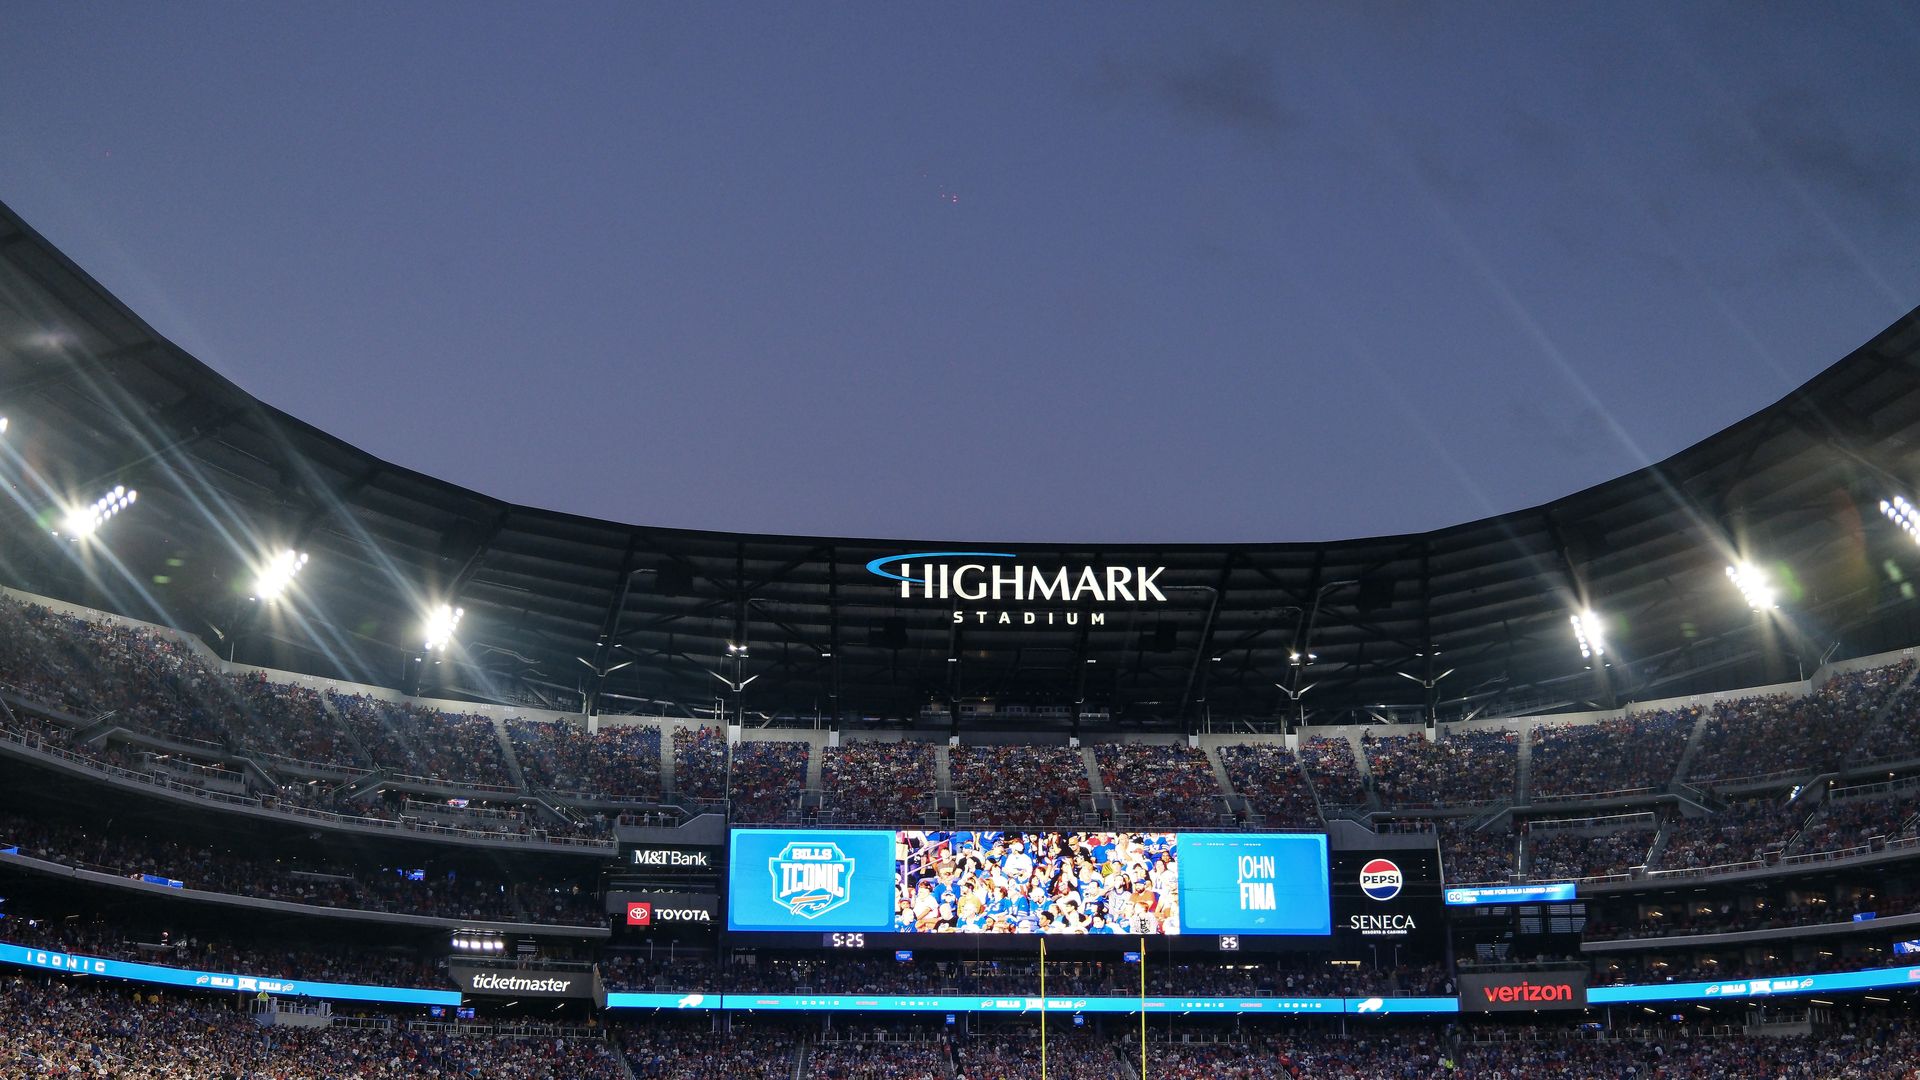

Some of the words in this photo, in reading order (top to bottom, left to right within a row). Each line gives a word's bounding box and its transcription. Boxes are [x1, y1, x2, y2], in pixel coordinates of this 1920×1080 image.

[900, 563, 1167, 601] HIGHMARK
[952, 611, 1105, 625] STADIUM
[634, 850, 670, 864] M&T
[671, 850, 707, 866] Bank
[792, 848, 833, 860] BILLS
[1237, 855, 1275, 884] JOHN
[779, 863, 844, 898] ICONIC
[1363, 875, 1399, 884] PEPSI
[1240, 882, 1276, 910] FINA
[654, 909, 710, 921] TOYOTA
[1350, 914, 1416, 929] SENECA
[832, 933, 864, 947] 5:25
[1222, 936, 1237, 949] 25
[26, 950, 106, 972] ICONIC
[472, 973, 571, 992] ticketmaster
[1484, 981, 1572, 1002] verizon
